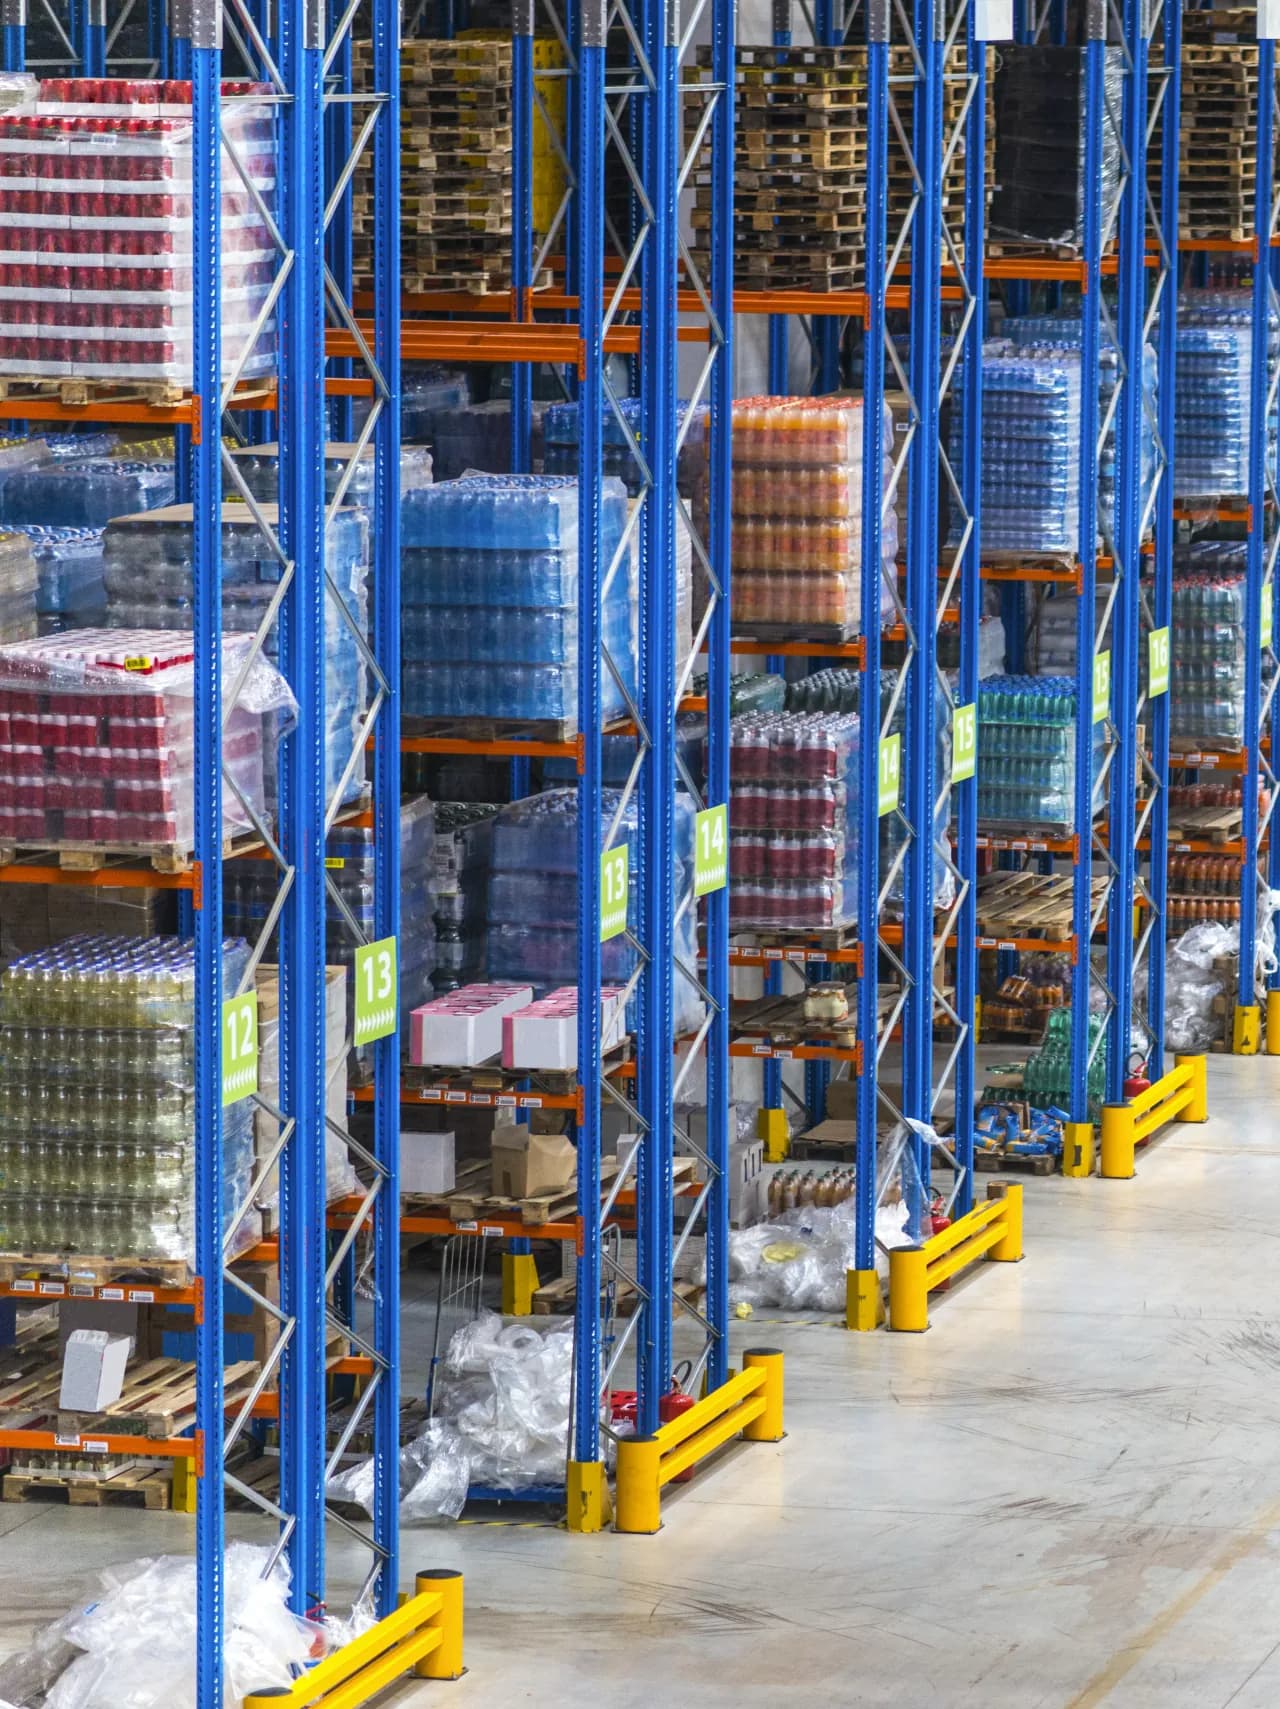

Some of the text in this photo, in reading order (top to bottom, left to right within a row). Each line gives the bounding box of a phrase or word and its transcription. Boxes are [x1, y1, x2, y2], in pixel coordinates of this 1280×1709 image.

[1152, 635, 1168, 670] 16
[1096, 659, 1108, 695] 15
[957, 713, 974, 752] 15
[882, 743, 898, 784] 14
[701, 815, 724, 860] 14
[604, 857, 624, 904] 13
[362, 950, 392, 1003] 13
[227, 1004, 254, 1061] 12
